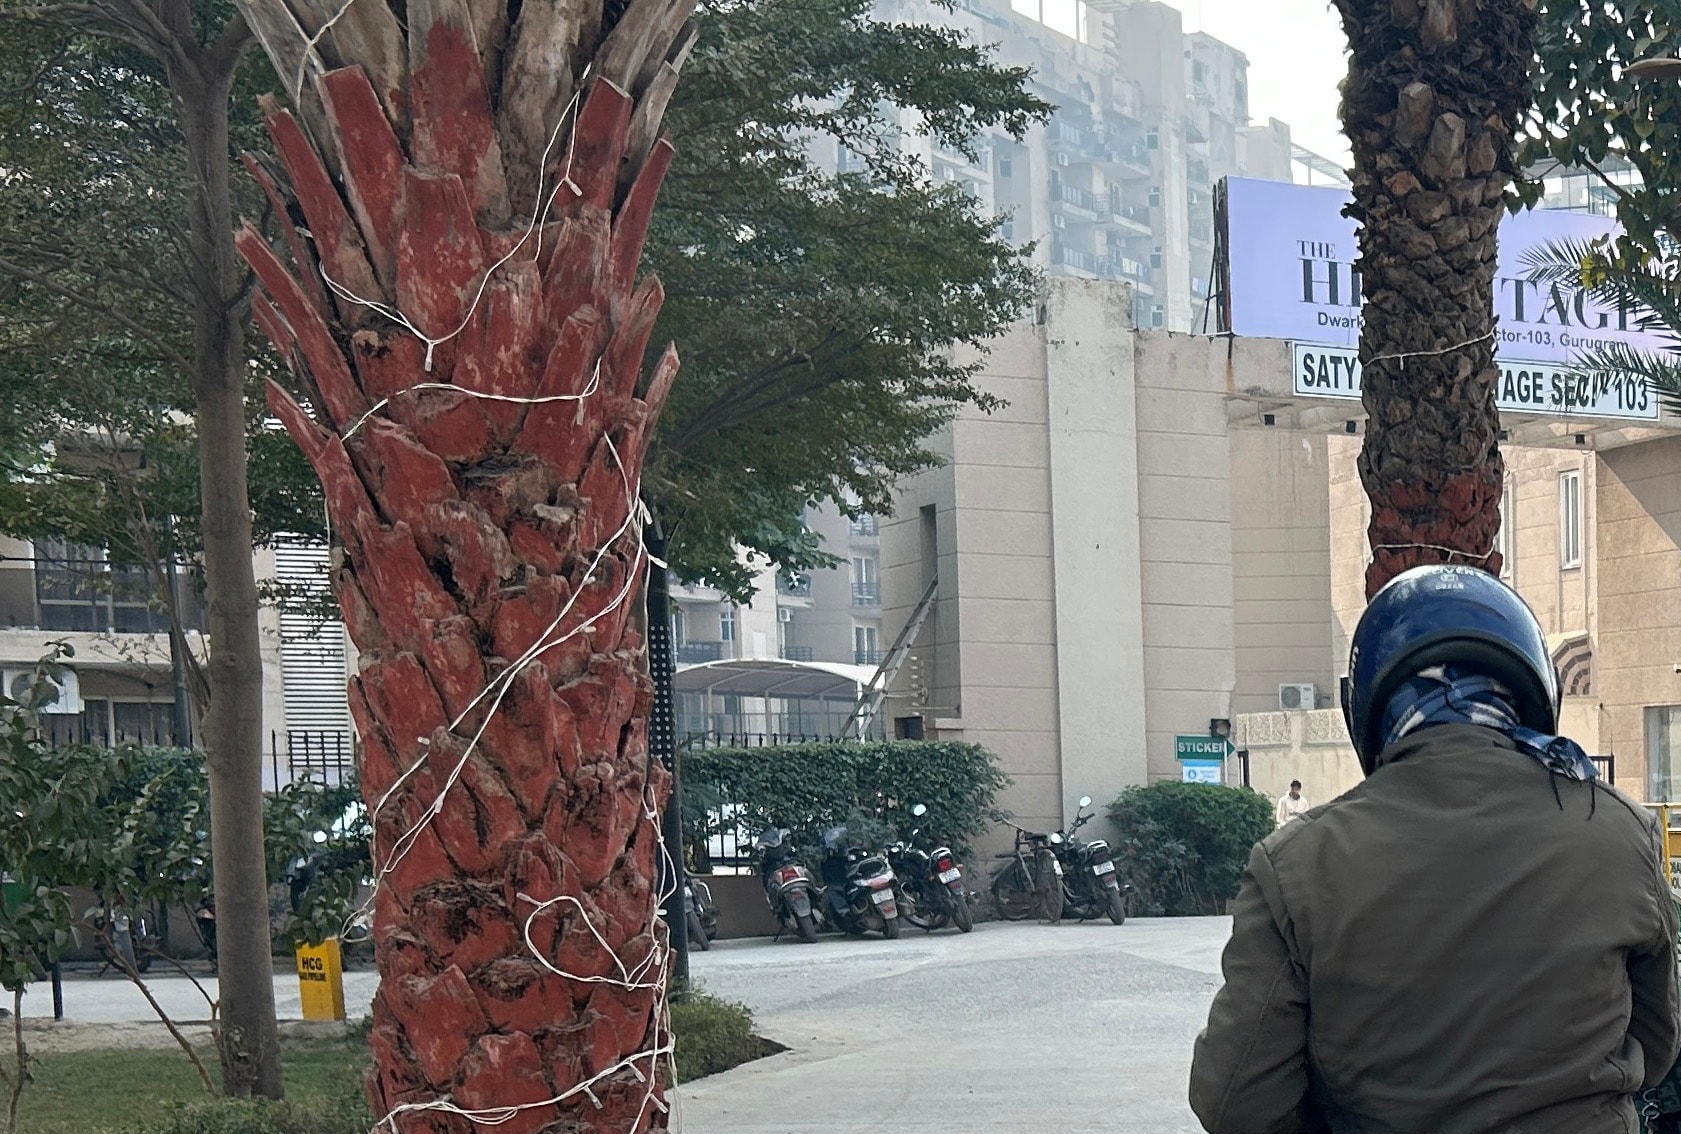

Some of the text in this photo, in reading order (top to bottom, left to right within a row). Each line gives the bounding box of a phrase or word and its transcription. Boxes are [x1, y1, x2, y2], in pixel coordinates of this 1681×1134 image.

[1296, 239, 1336, 260] THE
[1317, 311, 1364, 329] Dwark
[1496, 327, 1556, 349] ctor-103,
[1302, 352, 1363, 391] SATY
